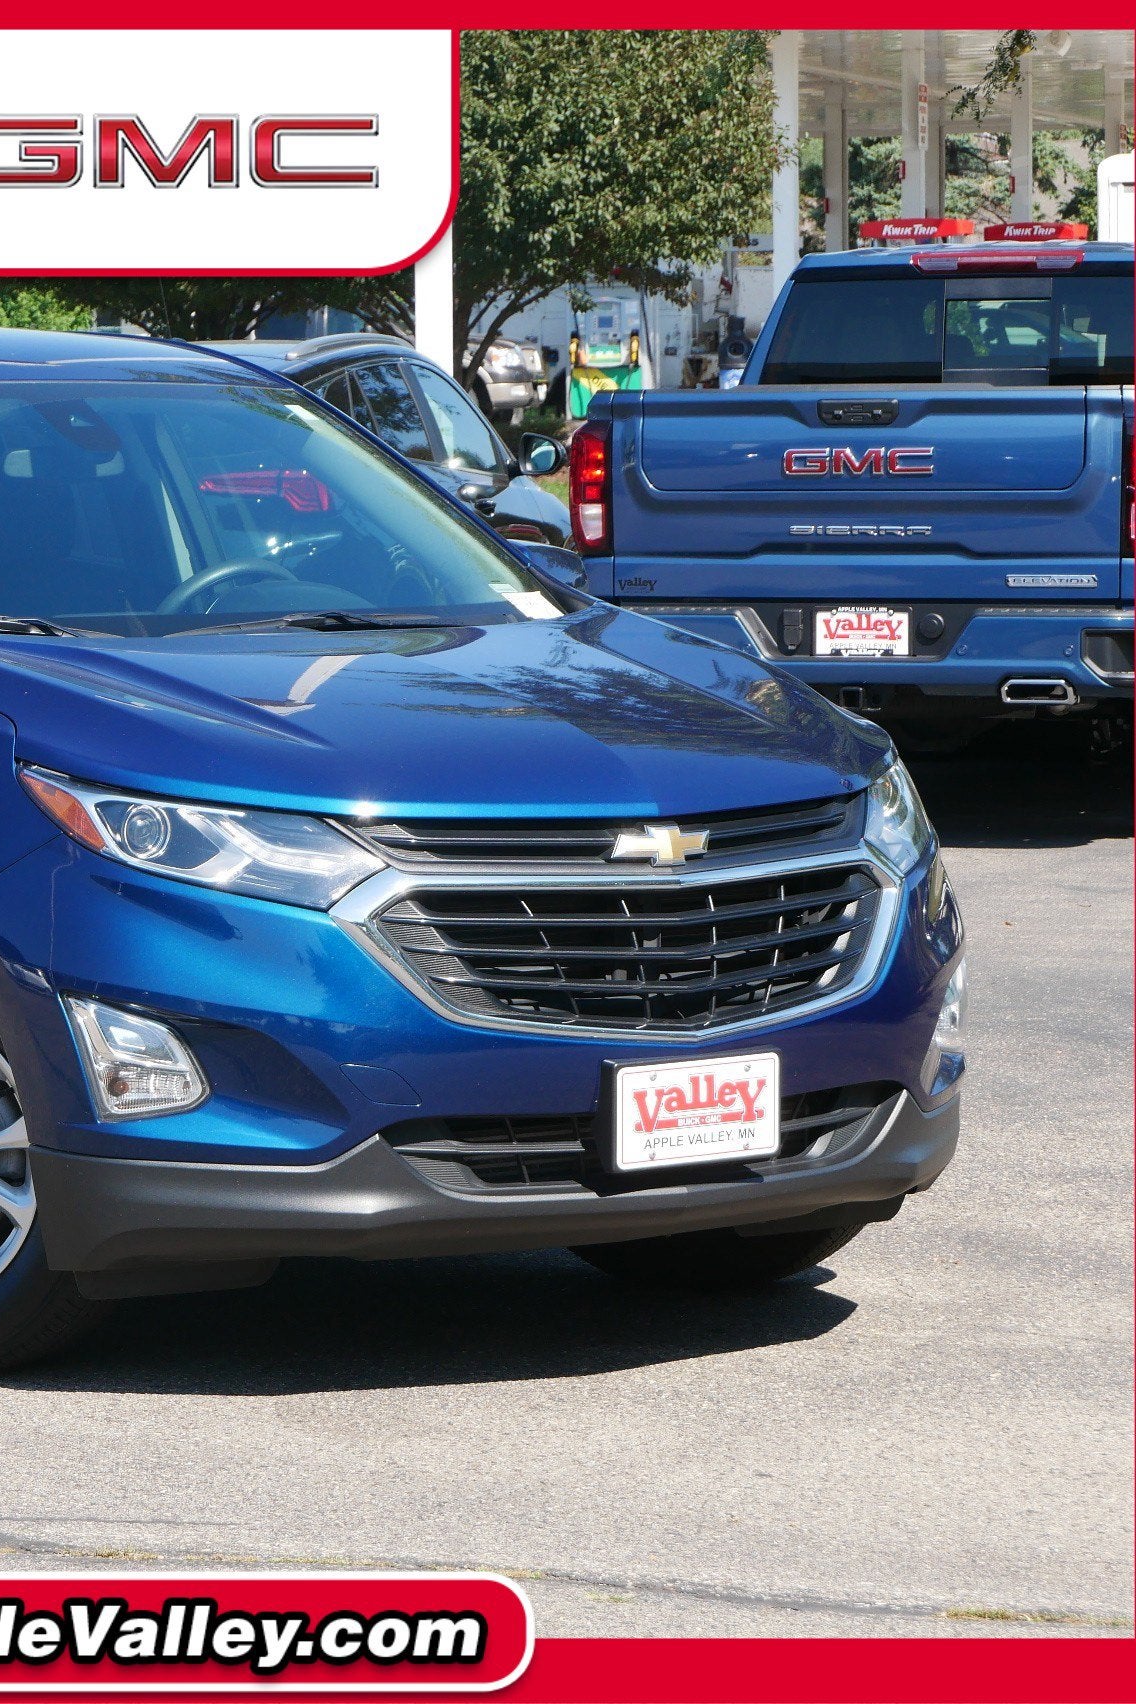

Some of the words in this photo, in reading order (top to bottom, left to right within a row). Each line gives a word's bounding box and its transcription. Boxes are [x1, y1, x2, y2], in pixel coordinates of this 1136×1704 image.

[783, 446, 934, 476] GMC
[789, 525, 932, 537] SIERRA
[678, 1115, 701, 1126] BUICK
[704, 1113, 722, 1124] GMC
[643, 1135, 684, 1150] APPLE
[738, 1127, 756, 1140] MN
